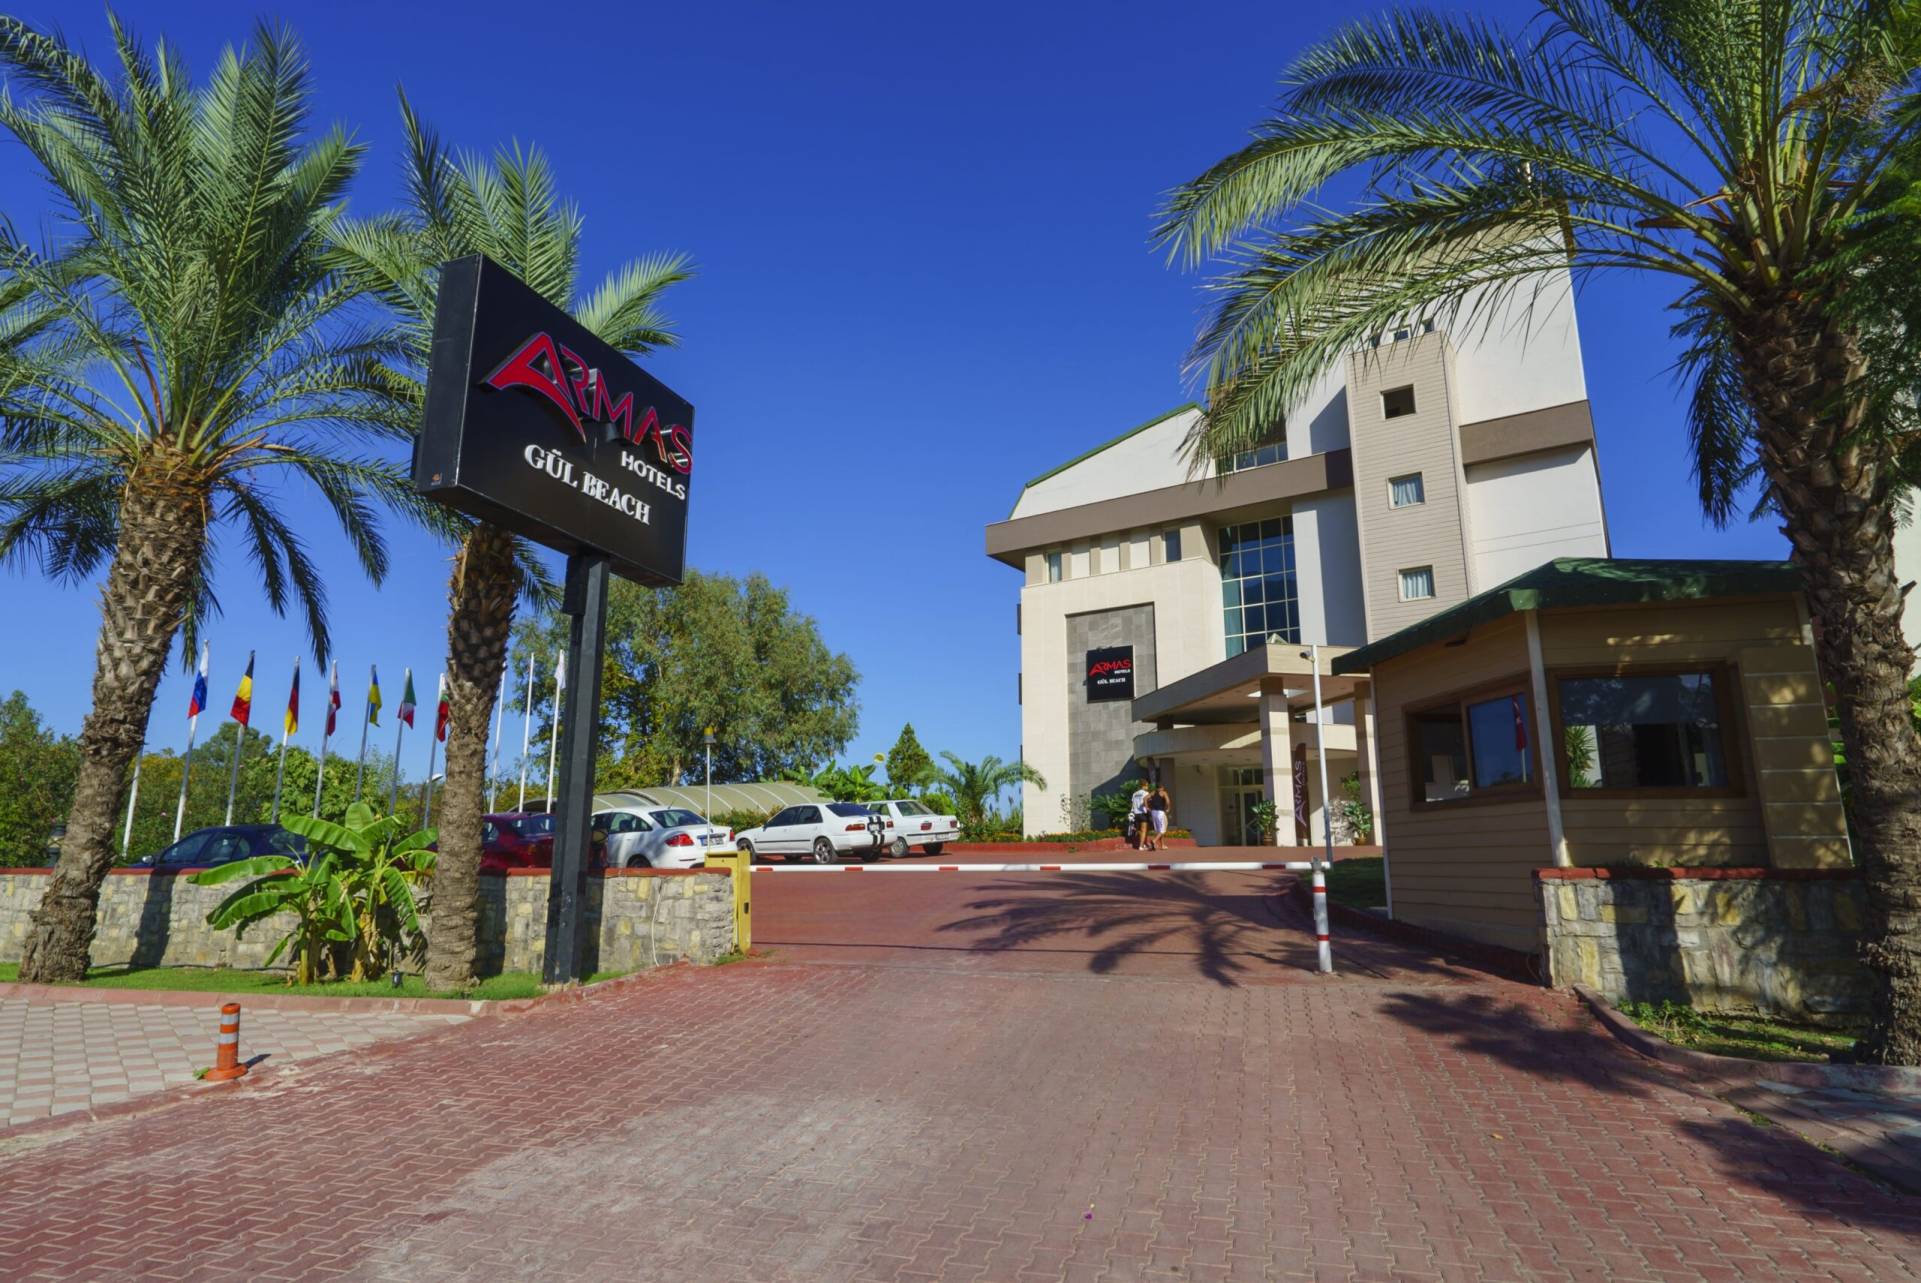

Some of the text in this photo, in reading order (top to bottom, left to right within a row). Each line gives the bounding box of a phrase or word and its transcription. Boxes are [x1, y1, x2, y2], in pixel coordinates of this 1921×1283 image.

[484, 331, 693, 474] ARMAS
[524, 444, 651, 526] GÜL BEACH
[620, 450, 686, 500] HOTELS
[1088, 659, 1132, 677] ARMAS
